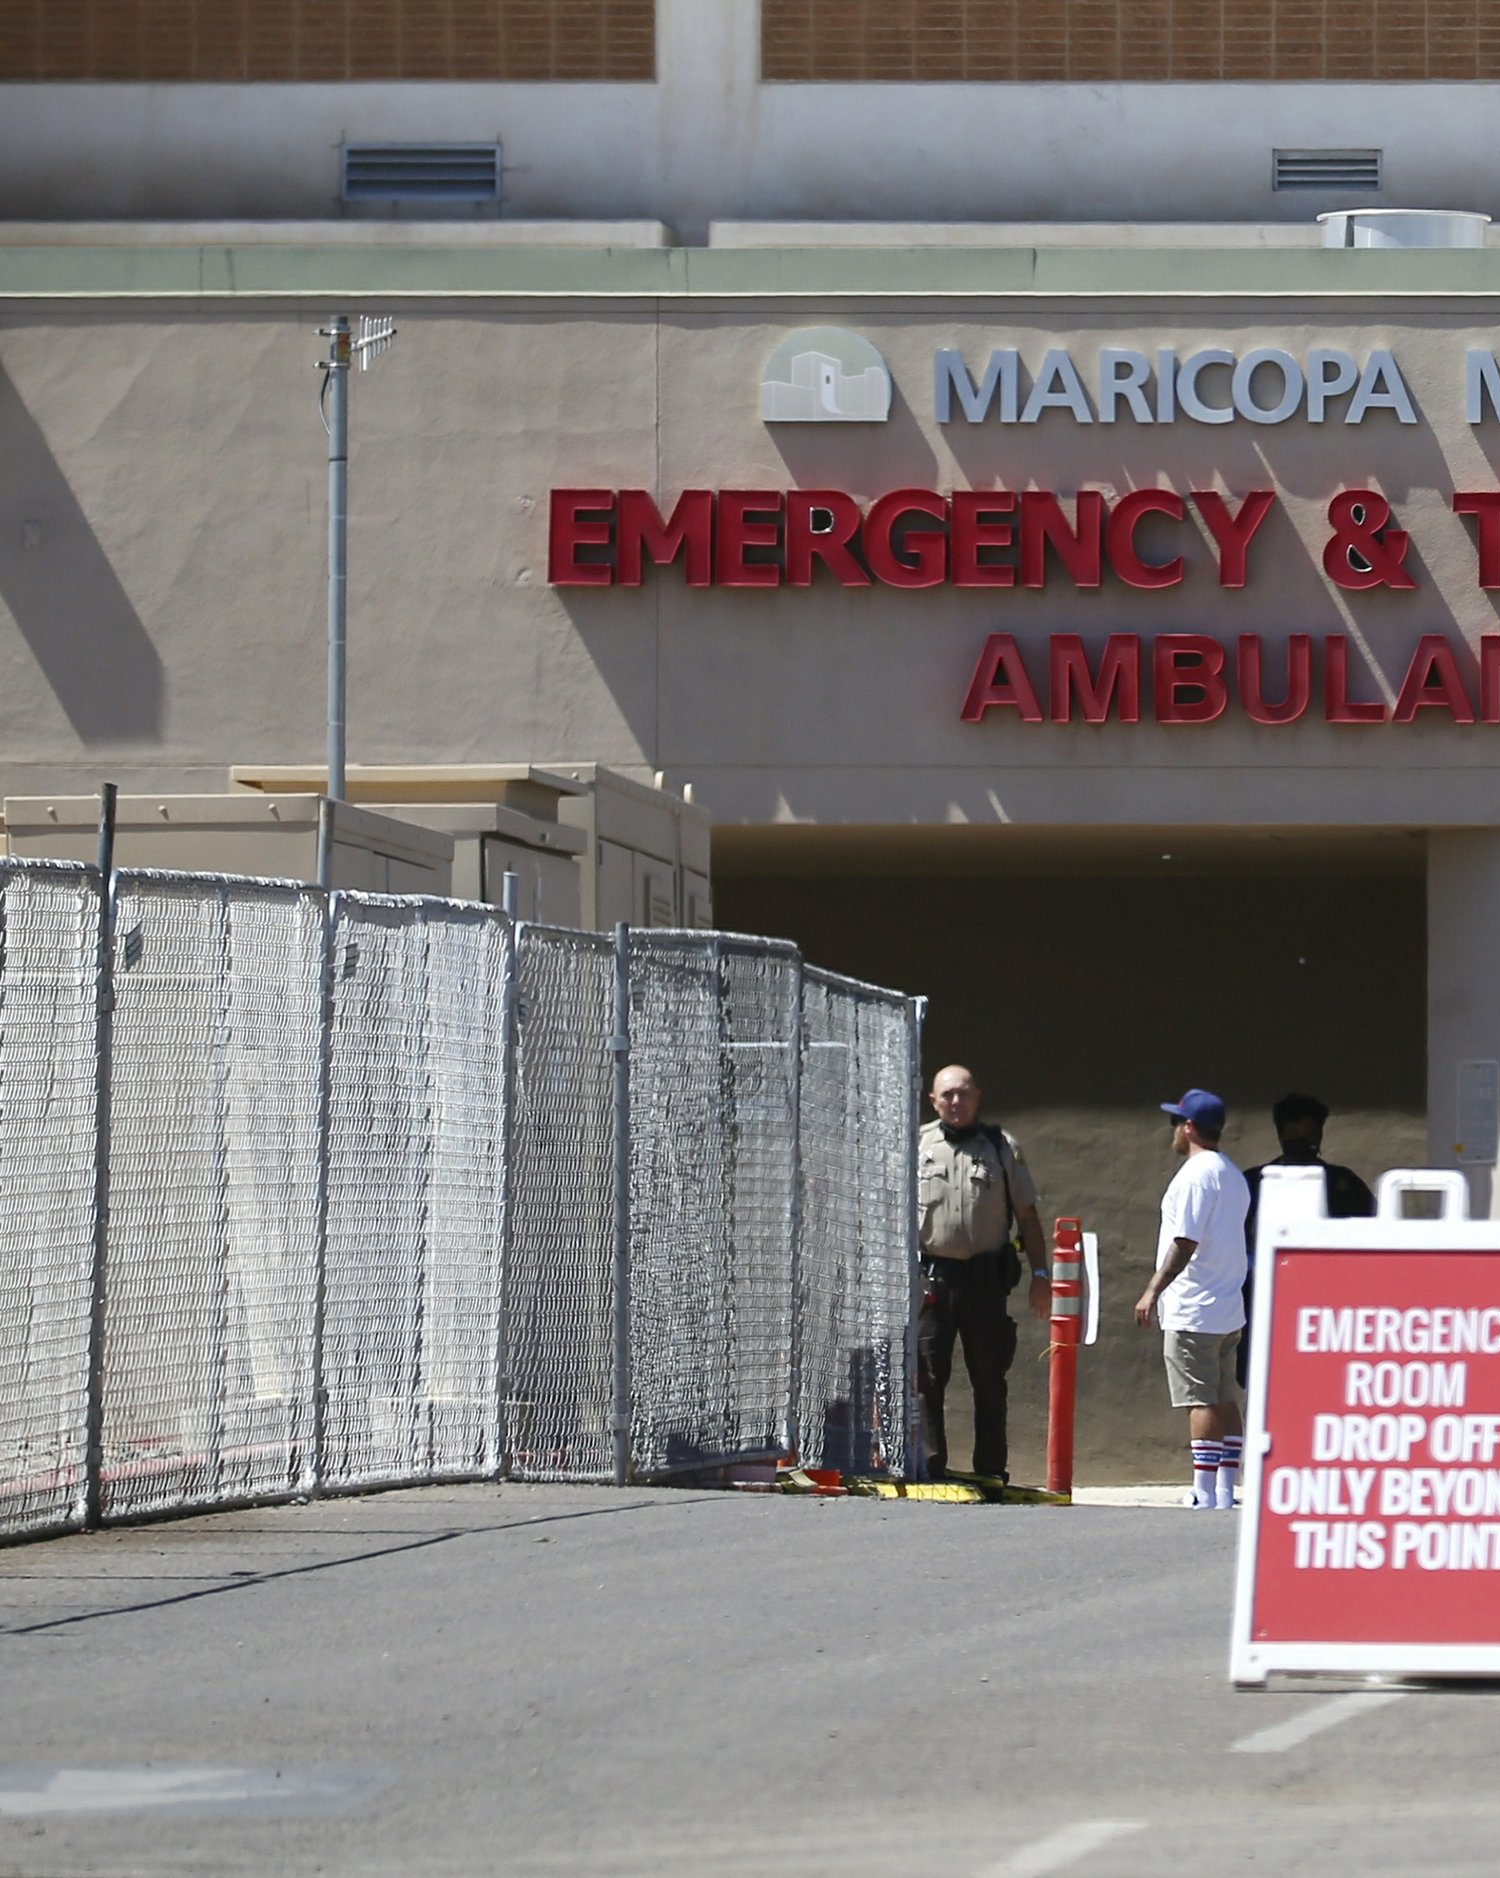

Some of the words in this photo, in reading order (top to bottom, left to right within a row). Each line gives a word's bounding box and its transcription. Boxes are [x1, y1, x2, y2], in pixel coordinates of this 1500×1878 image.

[934, 346, 1418, 425] MARICOPA
[549, 486, 1276, 591] EMERGENCY
[1322, 488, 1418, 591] &
[1345, 1360, 1468, 1408] ROOM
[1312, 1413, 1427, 1462] DROP
[1268, 1466, 1377, 1516] ONLY
[1289, 1520, 1387, 1570] THIS
